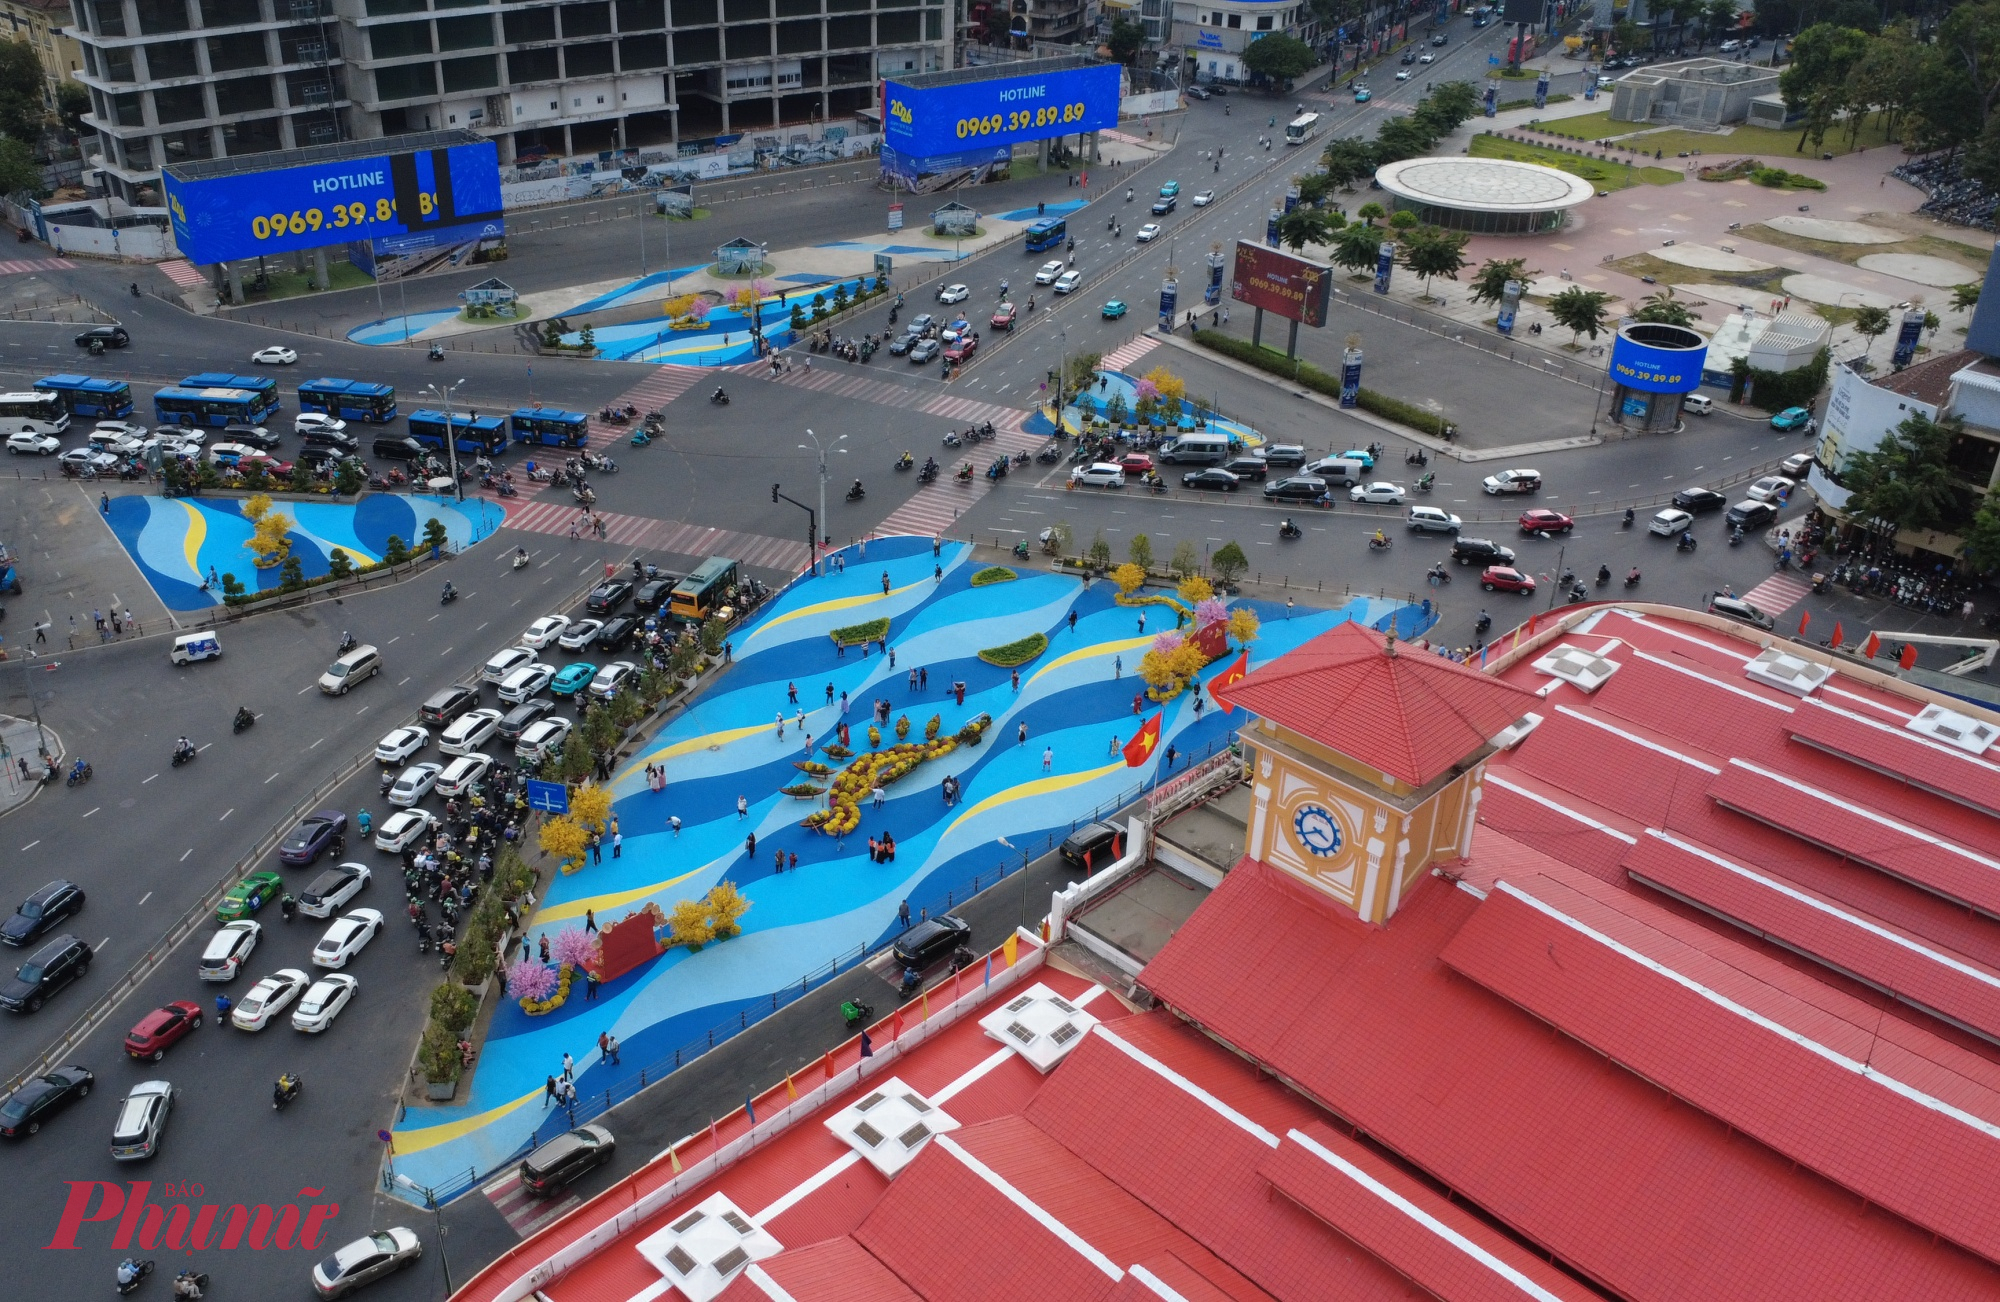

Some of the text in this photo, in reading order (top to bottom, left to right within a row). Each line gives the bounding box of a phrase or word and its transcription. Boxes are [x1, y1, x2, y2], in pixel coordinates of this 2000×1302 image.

[1000, 85, 1046, 102] HOTLINE
[891, 99, 912, 124] 2026
[956, 102, 1085, 139] 0969.39.89.89
[313, 171, 384, 193] HOTLINE
[1249, 277, 1304, 302] 0969.39.89.89
[1267, 273, 1289, 285] HOTLINE
[1616, 363, 1682, 384] 0969.39.89.89
[1634, 360, 1661, 370] HOTLINE
